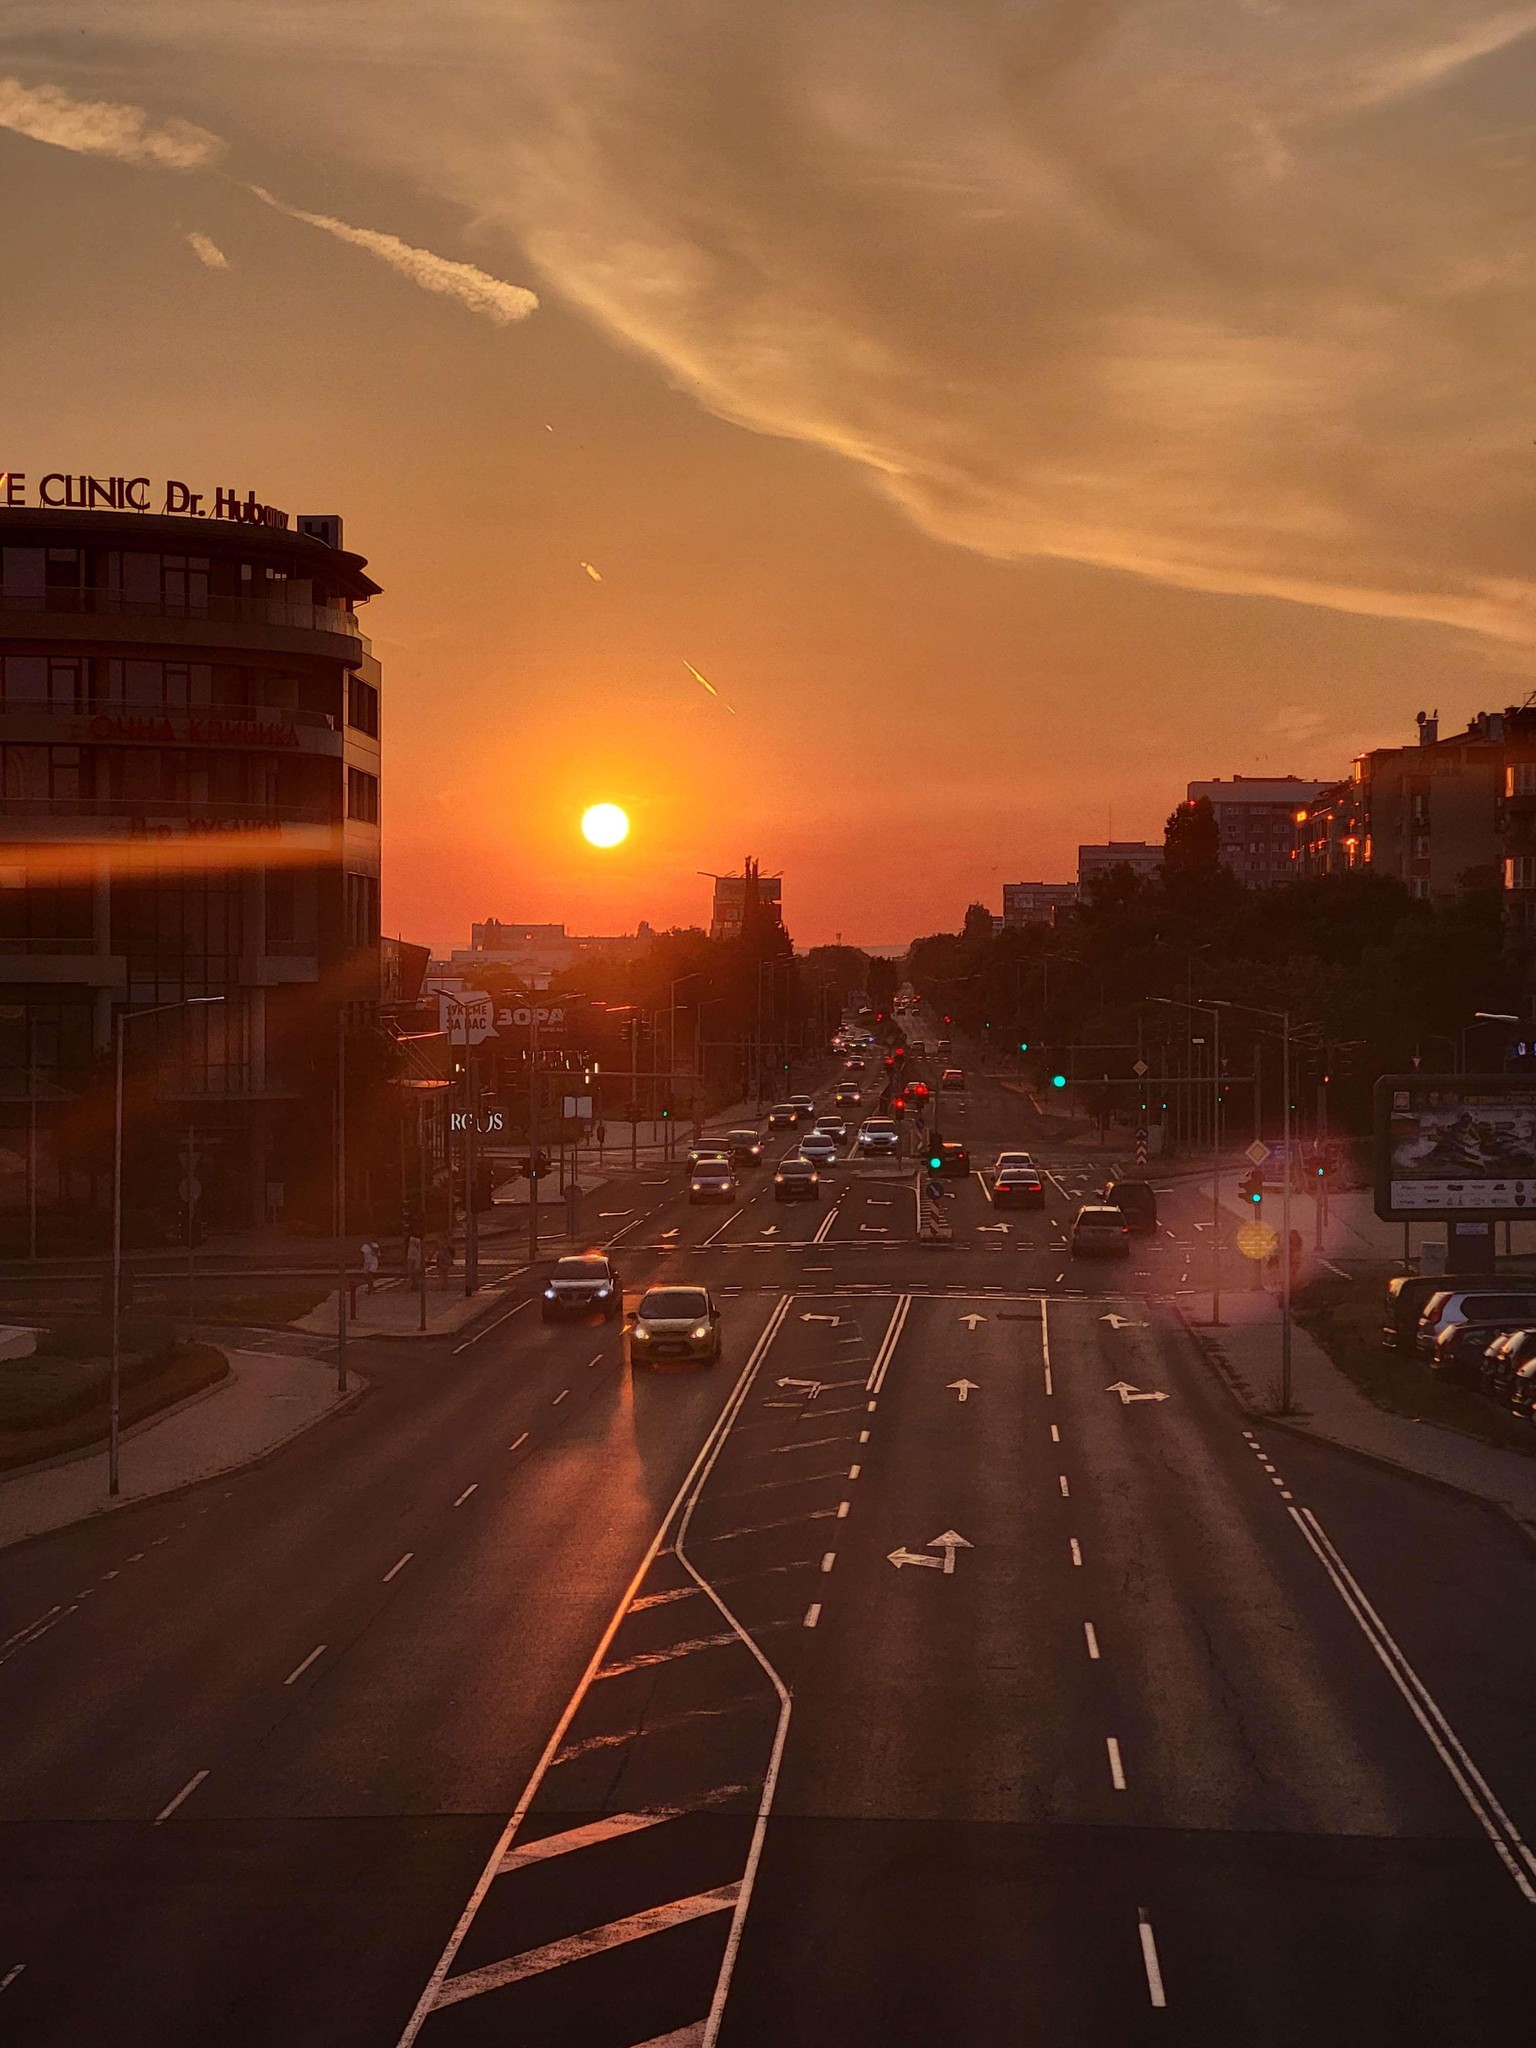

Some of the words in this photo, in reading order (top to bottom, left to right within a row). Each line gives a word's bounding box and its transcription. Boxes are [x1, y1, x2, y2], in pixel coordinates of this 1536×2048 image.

[39, 473, 150, 510] CLINIC
[167, 480, 207, 517] Dr.
[496, 1008, 564, 1026] ЗОРА
